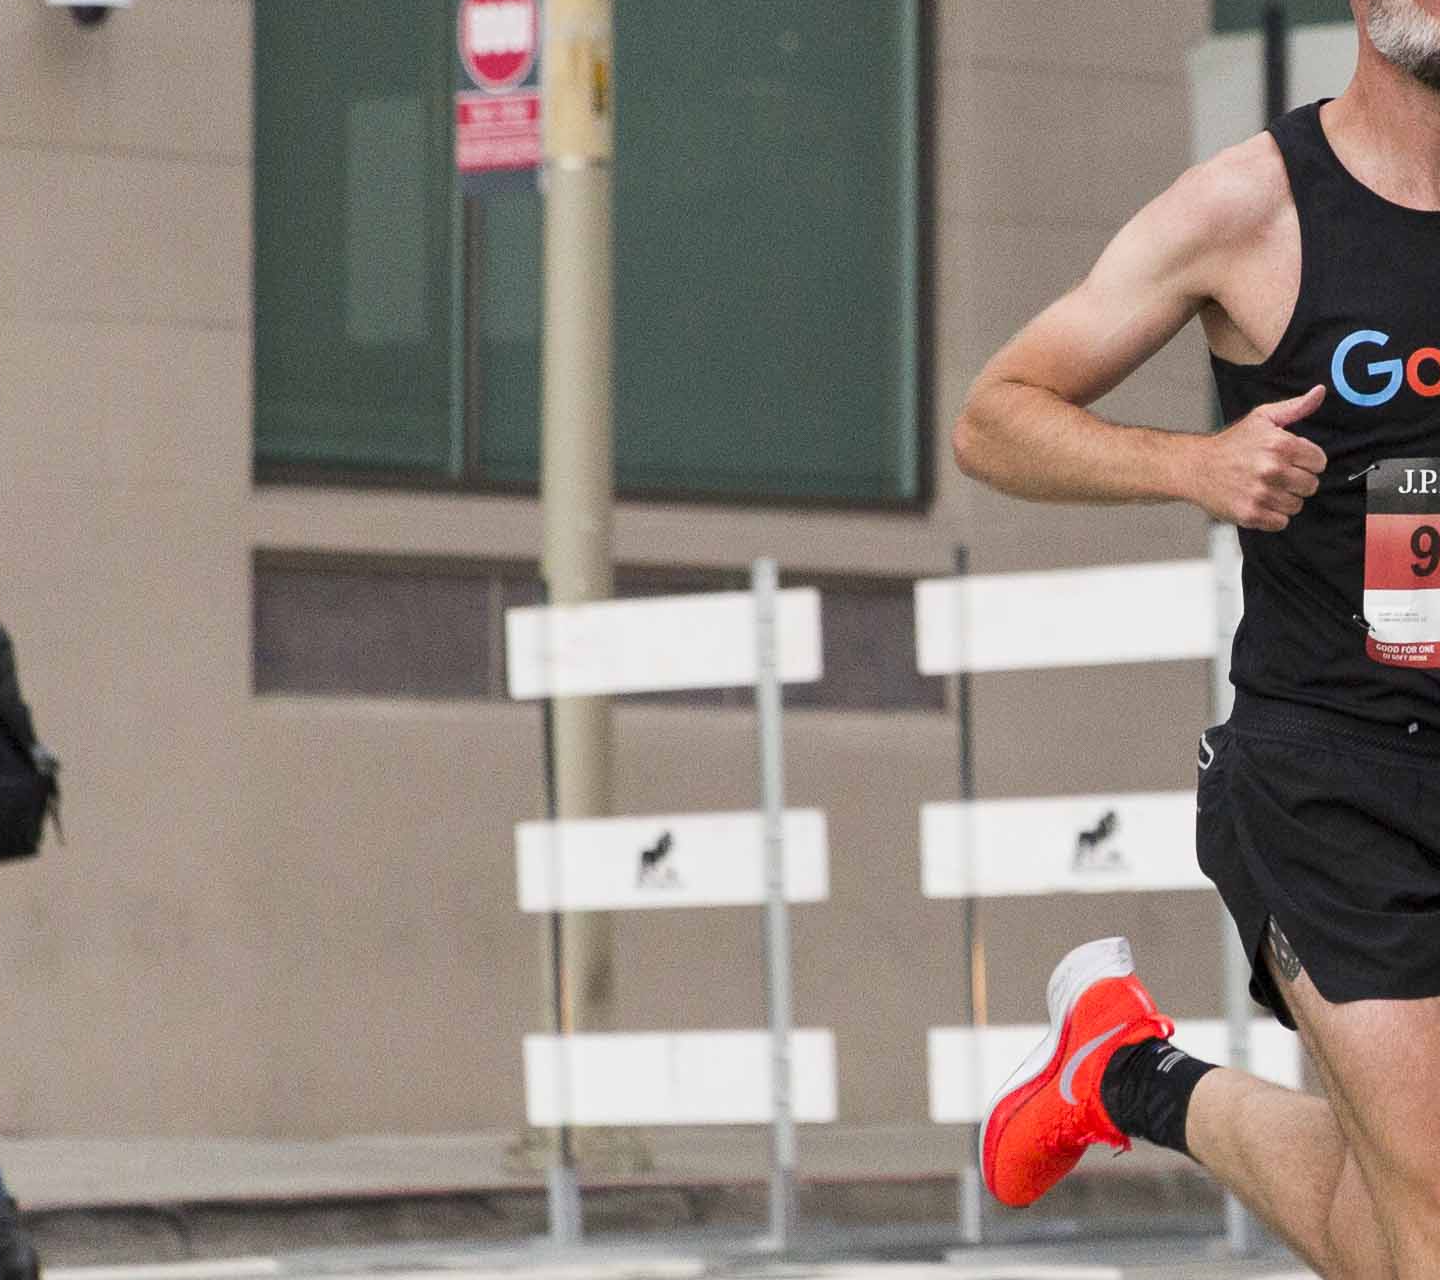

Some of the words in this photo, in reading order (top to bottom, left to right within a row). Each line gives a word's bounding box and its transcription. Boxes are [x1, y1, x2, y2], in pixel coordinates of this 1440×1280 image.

[1376, 644, 1399, 653] GOOD
[1401, 645, 1417, 654] FOR
[1418, 645, 1435, 653] ONE
